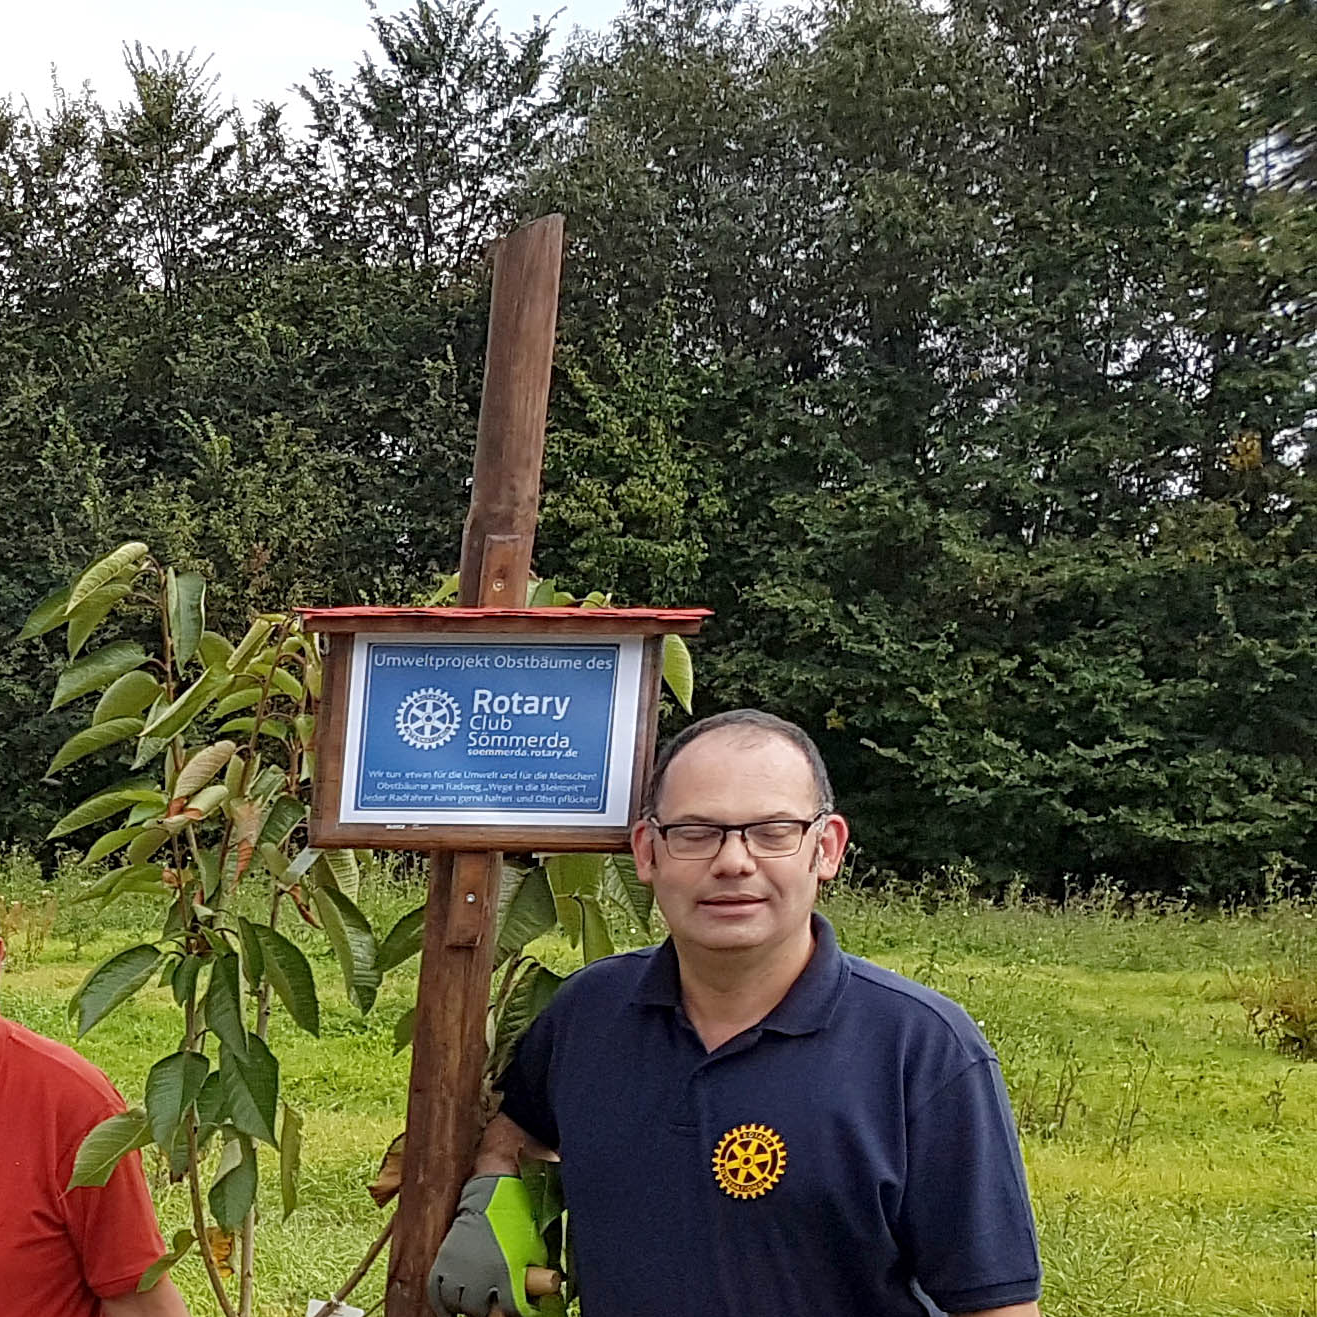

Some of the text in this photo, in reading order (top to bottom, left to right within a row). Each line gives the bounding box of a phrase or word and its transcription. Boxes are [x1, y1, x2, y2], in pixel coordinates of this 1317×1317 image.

[374, 653, 612, 671] Umweltprojekt Obstbäume des
[473, 689, 571, 720] Rotary
[469, 715, 512, 731] Club
[467, 731, 570, 748] Sömmerda
[467, 748, 579, 760] soemmerda.rotary.de
